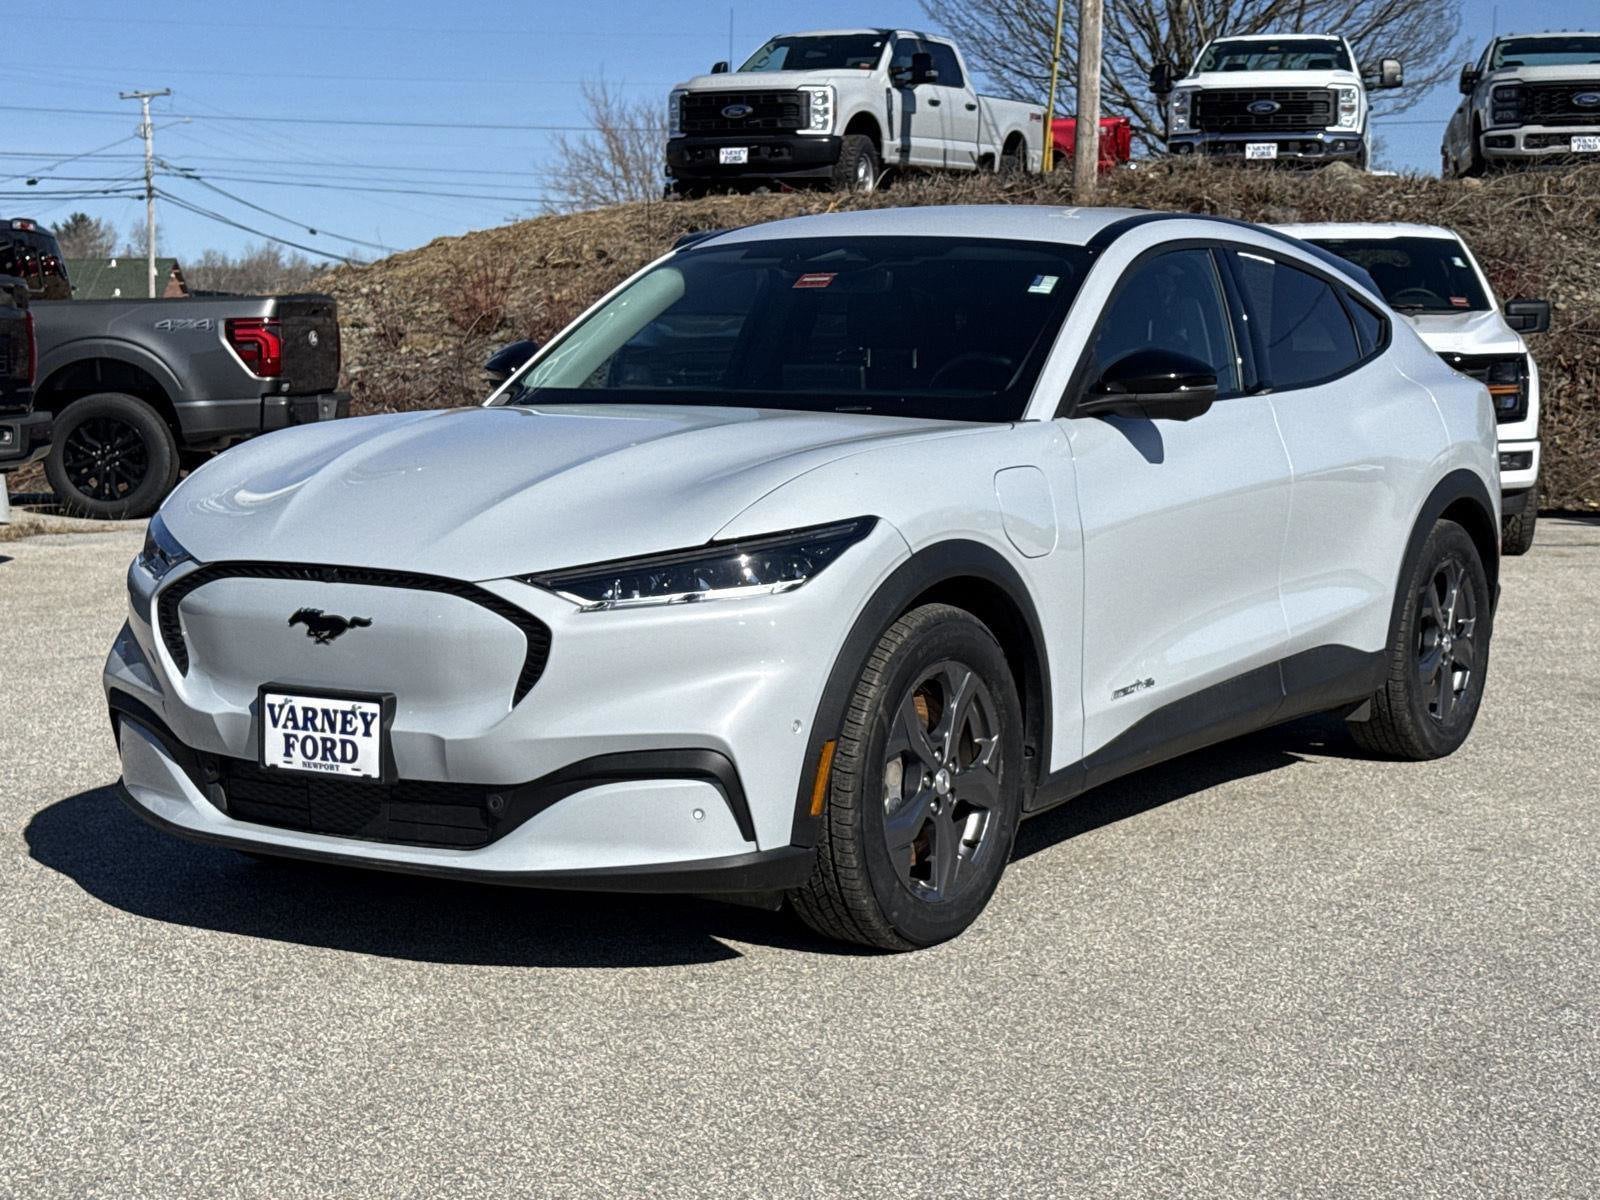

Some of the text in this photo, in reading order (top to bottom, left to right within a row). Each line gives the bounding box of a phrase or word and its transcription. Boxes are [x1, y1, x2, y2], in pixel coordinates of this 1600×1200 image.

[266, 703, 378, 738] VARNEY
[283, 732, 359, 765] FORD
[301, 760, 340, 772] NEWPORT
